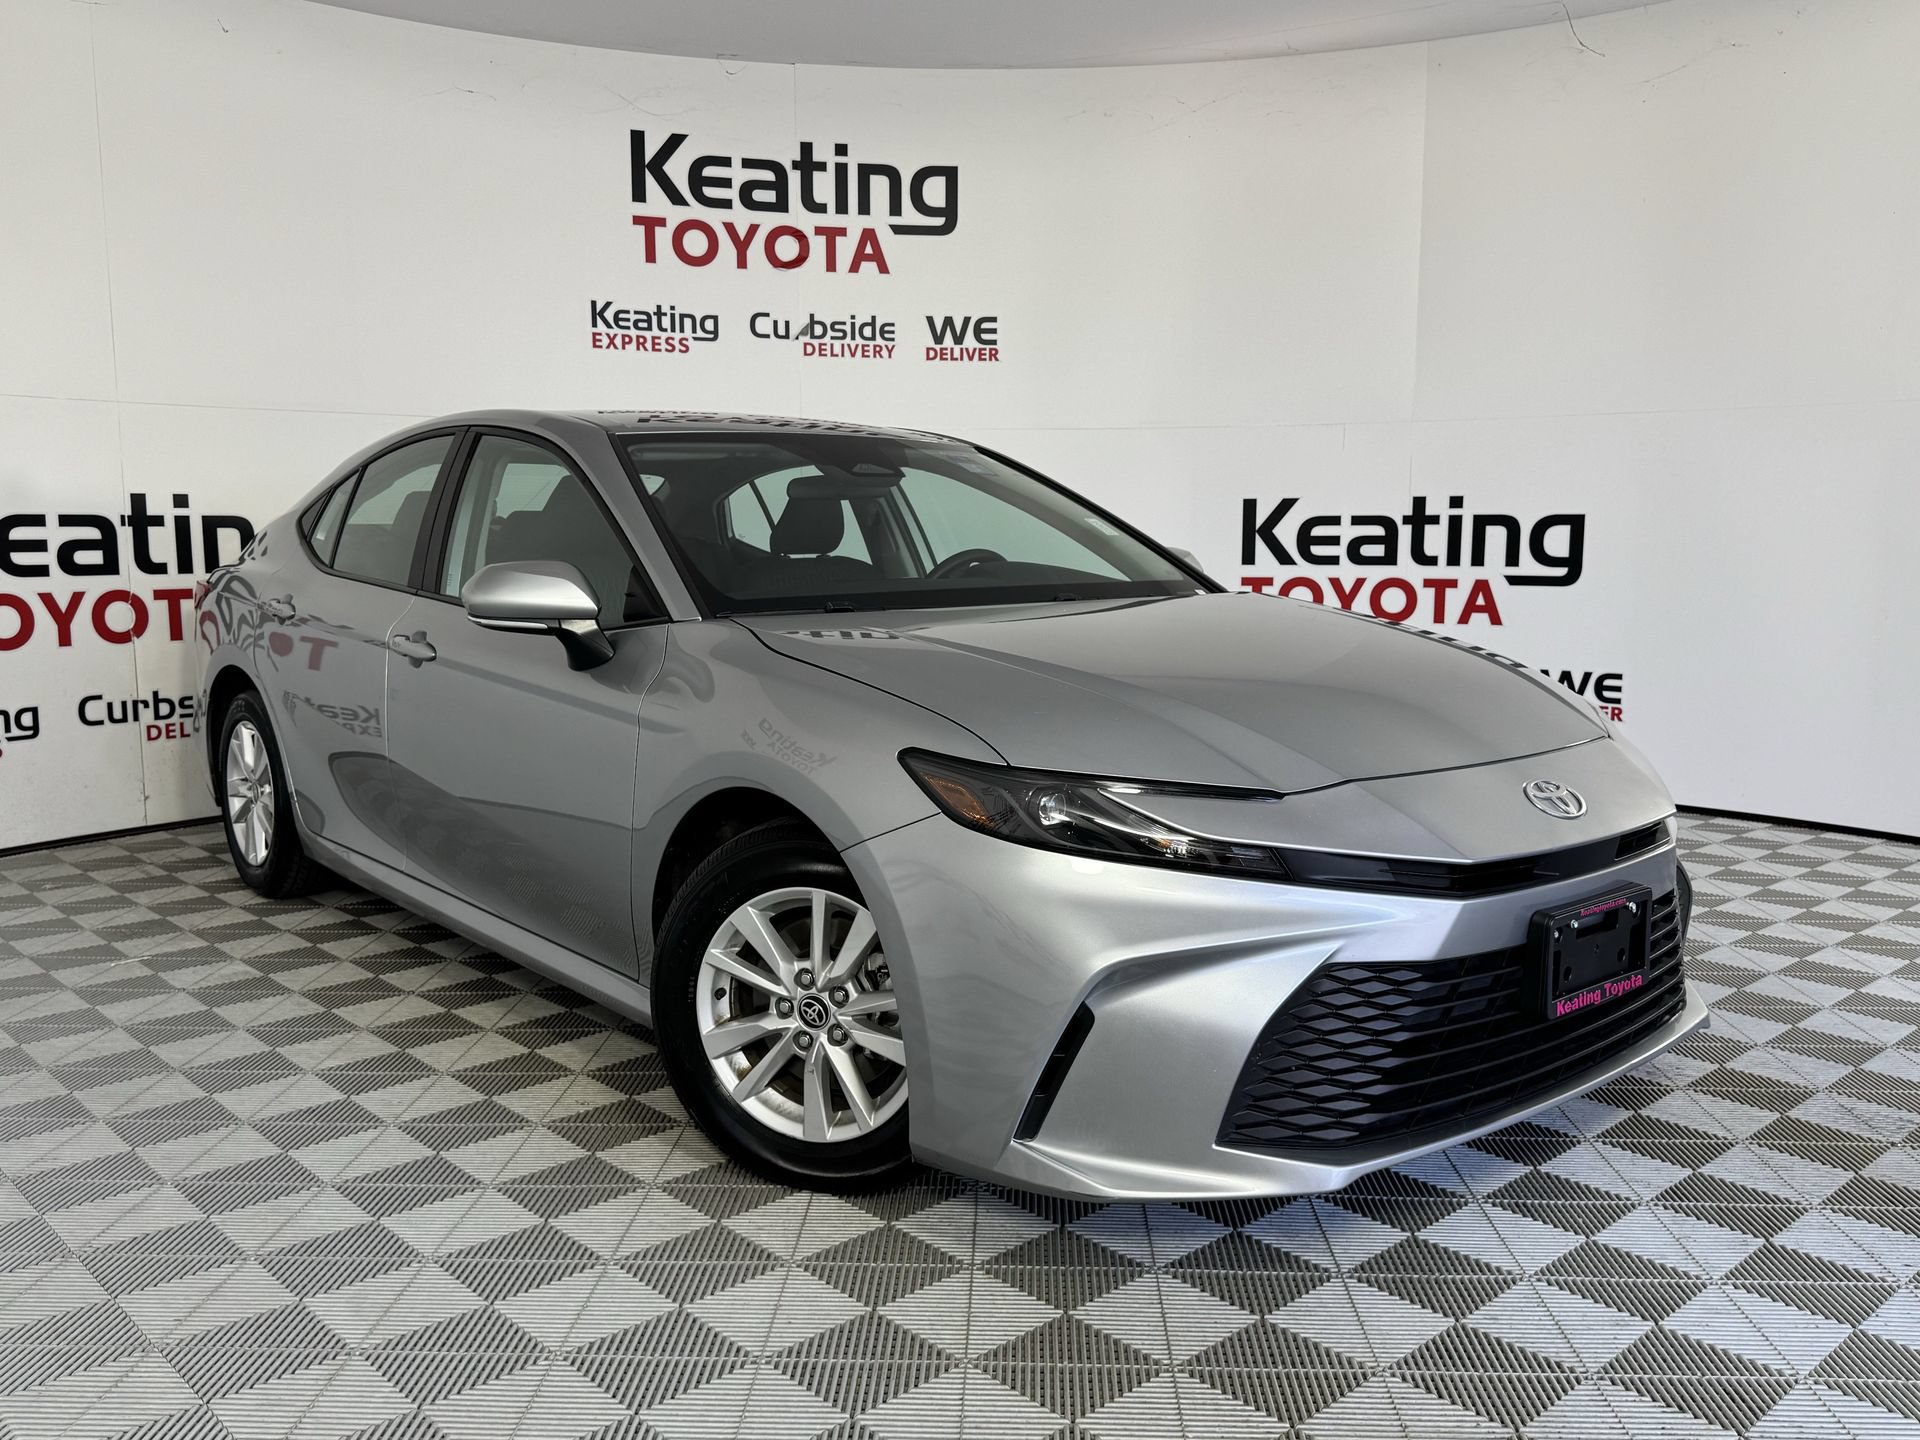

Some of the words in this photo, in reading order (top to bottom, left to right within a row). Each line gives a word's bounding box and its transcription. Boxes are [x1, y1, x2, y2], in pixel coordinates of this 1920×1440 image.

[630, 129, 959, 236] Keating
[632, 215, 890, 274] TOYOTA
[590, 300, 719, 341] Keating
[750, 312, 896, 341] Cubside
[926, 316, 998, 345] WE
[592, 332, 690, 353] EXPRESS
[803, 342, 896, 359] DELIVERY
[925, 347, 1000, 362] DELIVER
[0, 493, 254, 577] eatin
[1241, 496, 1586, 587] Keating
[0, 589, 193, 651] OYOT
[78, 690, 194, 726] Curbs
[1556, 989, 1601, 1016] Keating
[1604, 974, 1643, 997] Toyota
